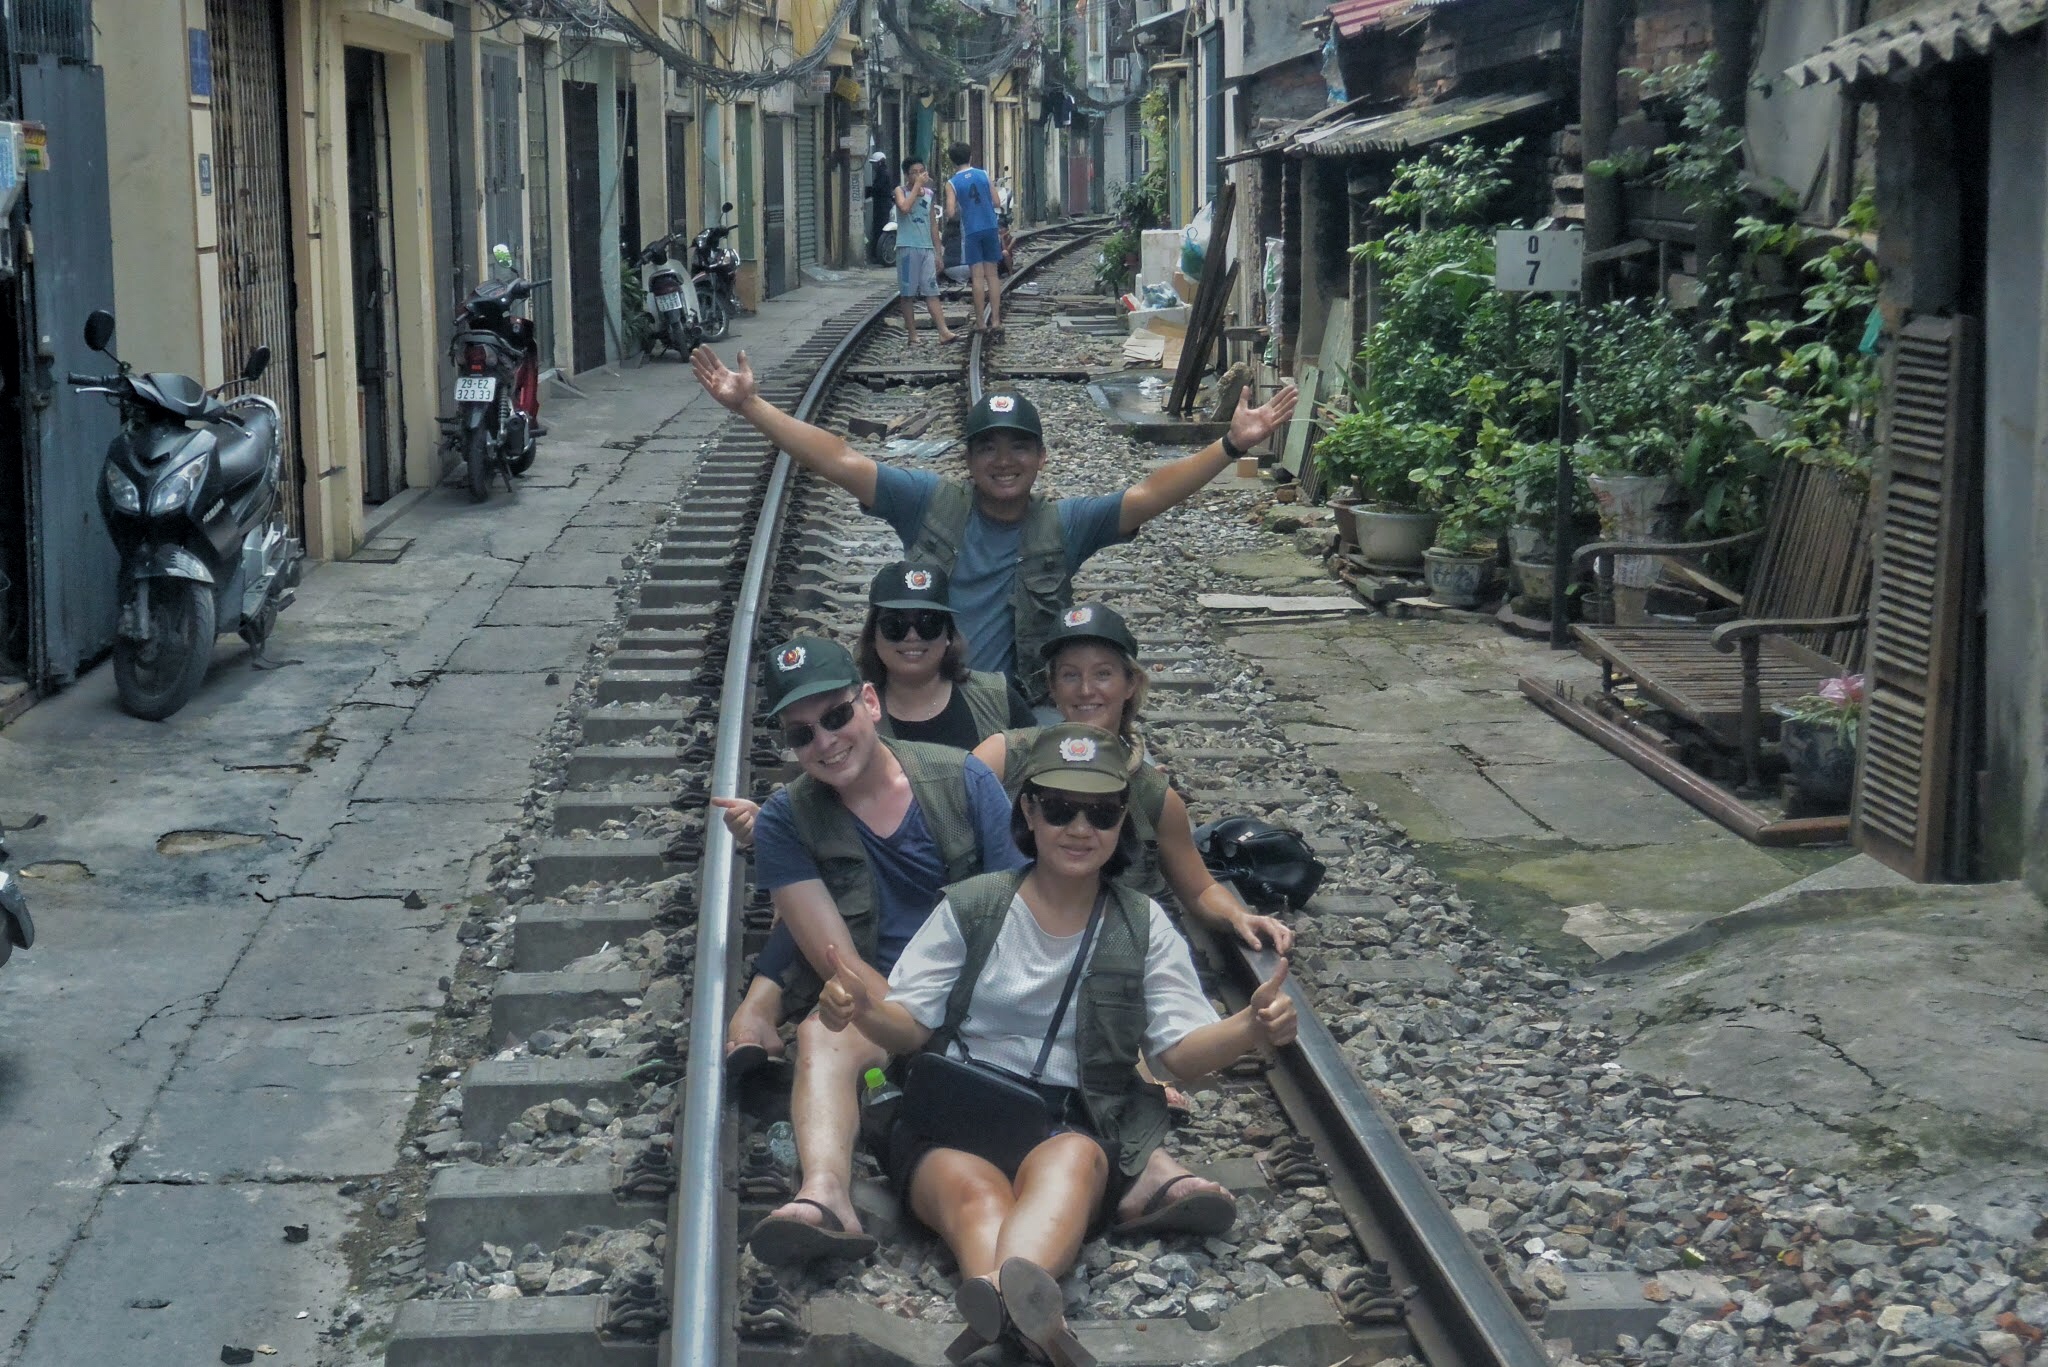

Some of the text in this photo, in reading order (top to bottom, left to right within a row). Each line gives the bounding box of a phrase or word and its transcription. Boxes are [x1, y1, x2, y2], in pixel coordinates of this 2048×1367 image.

[968, 182, 981, 205] 4
[1525, 260, 1542, 286] 7
[461, 378, 489, 389] 29-E2
[456, 389, 491, 400] 323.33
